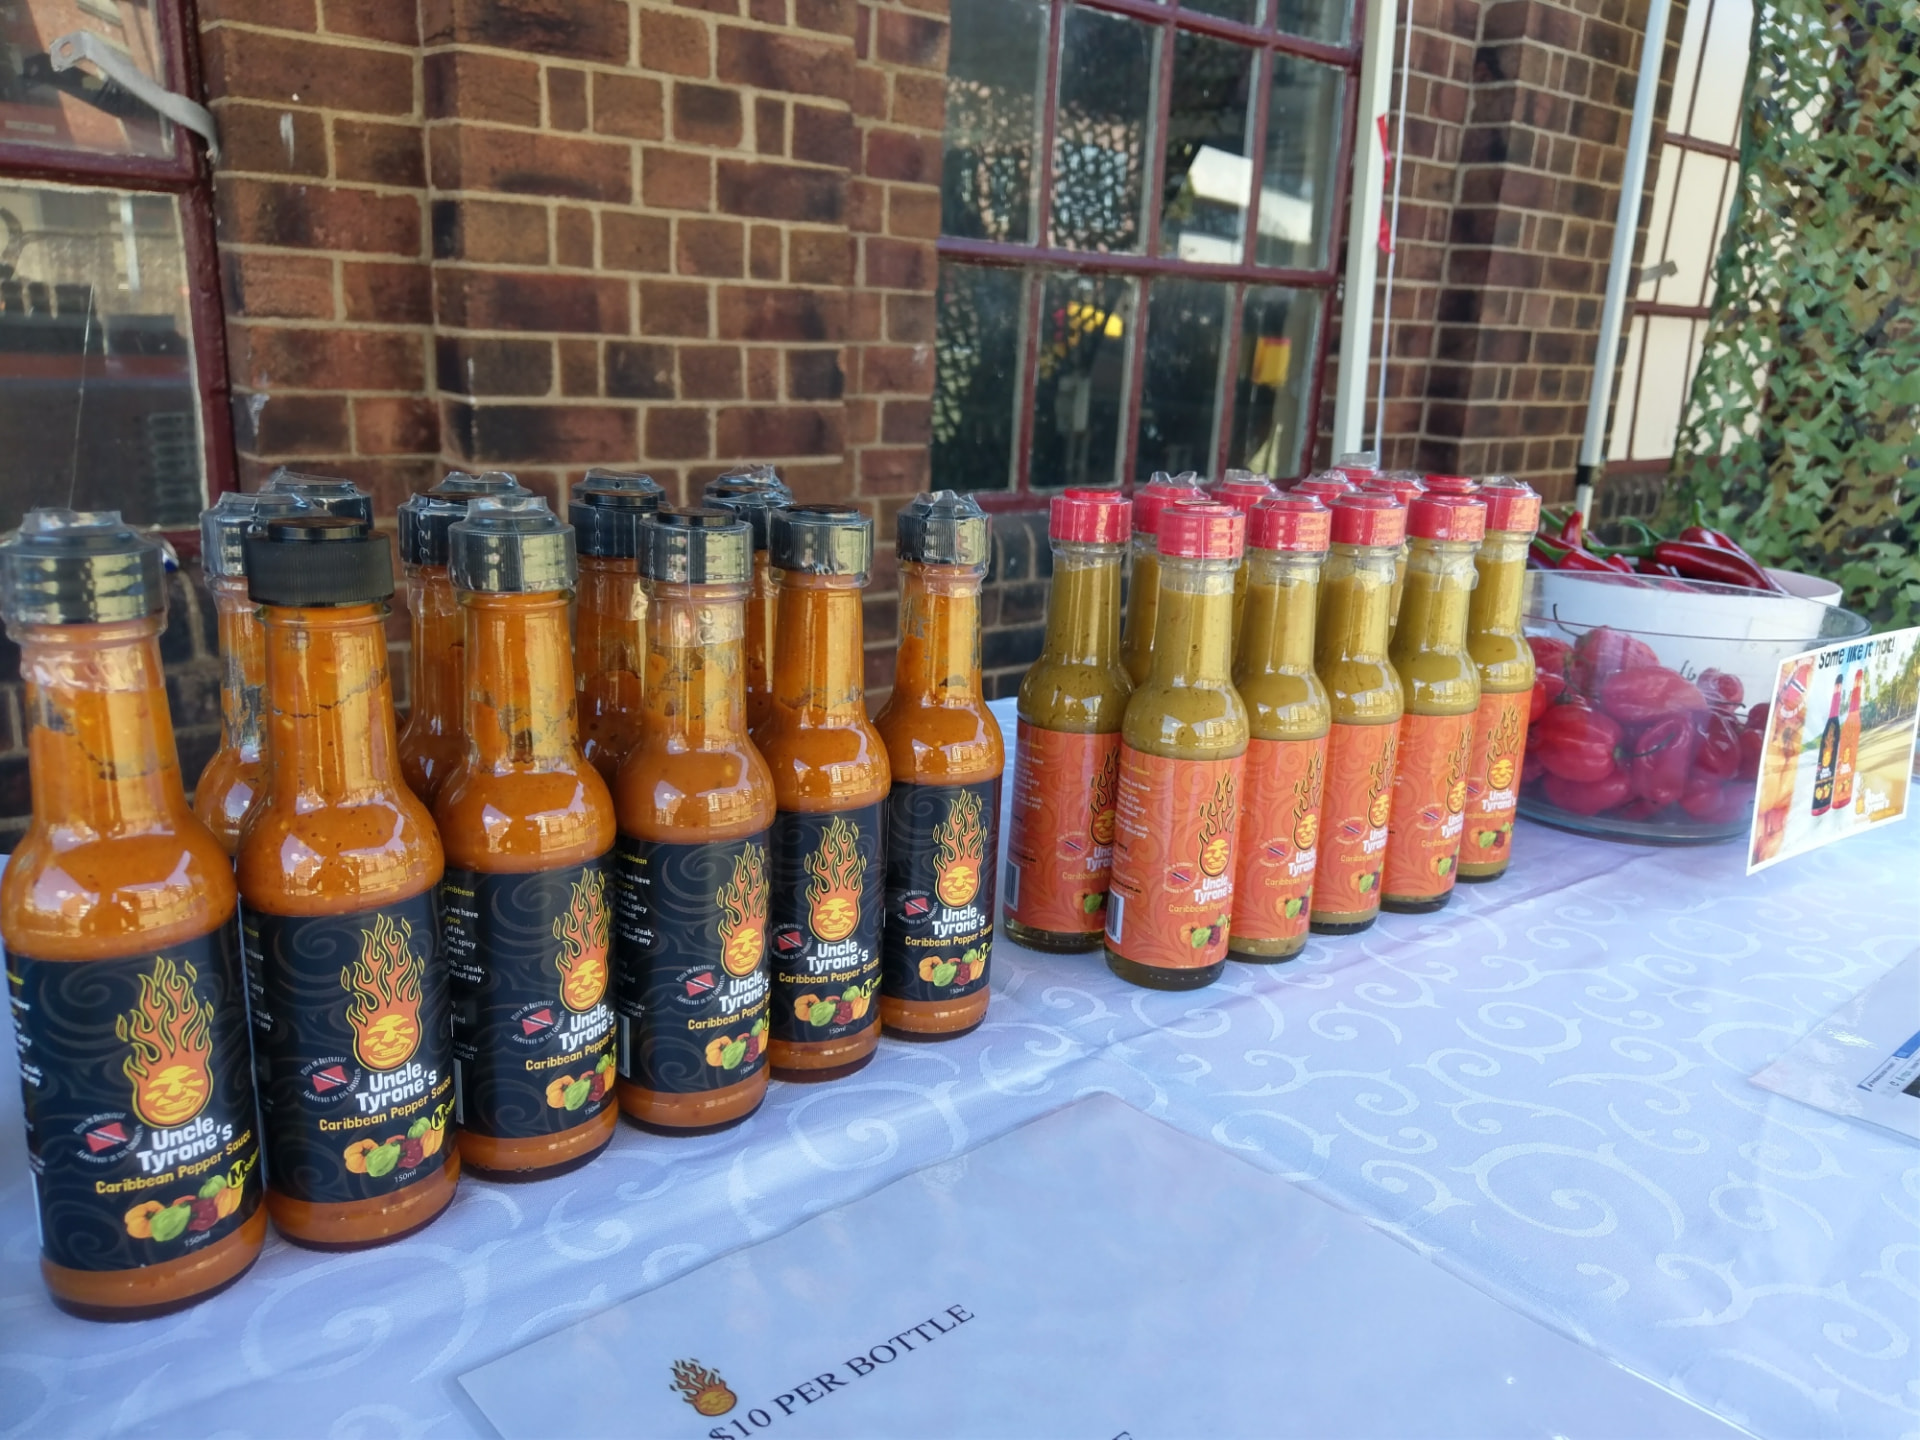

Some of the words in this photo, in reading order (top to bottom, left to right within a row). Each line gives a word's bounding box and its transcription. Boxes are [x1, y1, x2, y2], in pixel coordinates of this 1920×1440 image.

[1818, 647, 1845, 669] Some
[1847, 644, 1864, 663] like
[1864, 641, 1873, 659] it
[1094, 846, 1112, 858] Unc
[1193, 882, 1232, 905] Tyrone's
[1202, 873, 1228, 891] Uncle
[461, 907, 479, 919] have
[932, 913, 986, 938] Tyrone's
[942, 905, 976, 922] Uncle
[454, 926, 465, 936] the
[905, 935, 951, 947] Caribbean
[953, 932, 979, 946] Pepper
[458, 939, 476, 950] spicy
[817, 939, 857, 958] Uncle
[463, 963, 485, 974] steak,
[806, 948, 869, 975] Tyrone's
[468, 973, 482, 984] any
[729, 970, 763, 996] Uncle
[779, 972, 828, 984] Caribbean
[831, 967, 861, 983] Pepper
[719, 977, 769, 1015] Tyrone's
[570, 1003, 607, 1032] Uncle
[688, 1013, 739, 1030] Caribbean
[741, 998, 765, 1019] Pepper
[559, 1011, 614, 1052] Tyrone's
[526, 1051, 582, 1071] Caribbean
[585, 1034, 610, 1056] Pepper
[369, 1062, 421, 1093] Uncle
[355, 1069, 437, 1114] Tyrone's
[319, 1112, 387, 1132] Caribbean
[391, 1095, 428, 1119] Pepper
[152, 1116, 215, 1151] Uncle
[136, 1123, 233, 1174] Tyrone's
[95, 1172, 175, 1195] Caribbean
[178, 1151, 223, 1179] Pepper
[226, 1129, 251, 1156] Sauce
[394, 1169, 416, 1183] 150ml
[708, 1408, 773, 1440] $10
[769, 1372, 850, 1416] PER
[842, 1303, 976, 1377] BOTTLE
